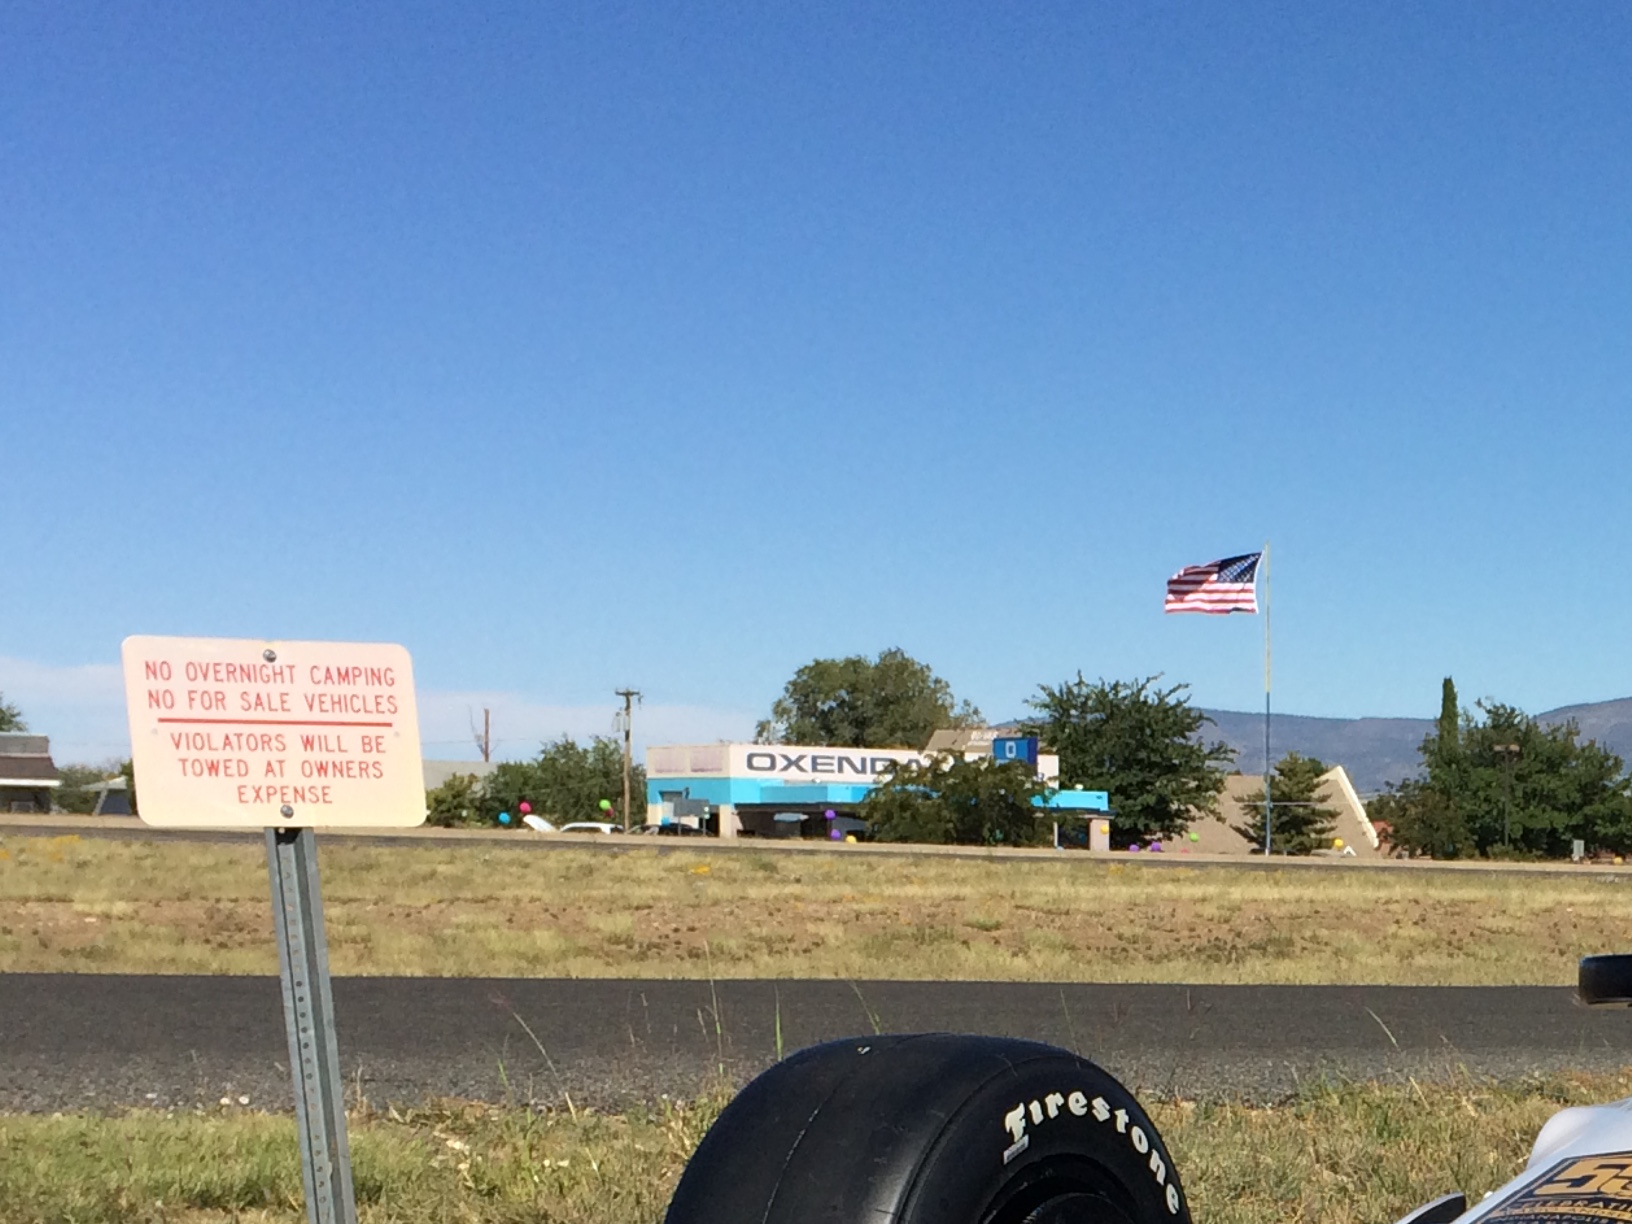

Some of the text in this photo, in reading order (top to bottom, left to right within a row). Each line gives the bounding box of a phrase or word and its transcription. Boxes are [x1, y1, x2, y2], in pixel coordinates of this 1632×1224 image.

[145, 661, 396, 687] NO OVERNIGHT CAMPING
[148, 689, 398, 715] NO FOR SALE VEHICLES
[170, 732, 387, 754] VIOLATORS WILL BE
[178, 758, 384, 779] TOWED AT OWNERS
[237, 785, 333, 804] EXPENSE
[1004, 1091, 1180, 1216] Firestone
